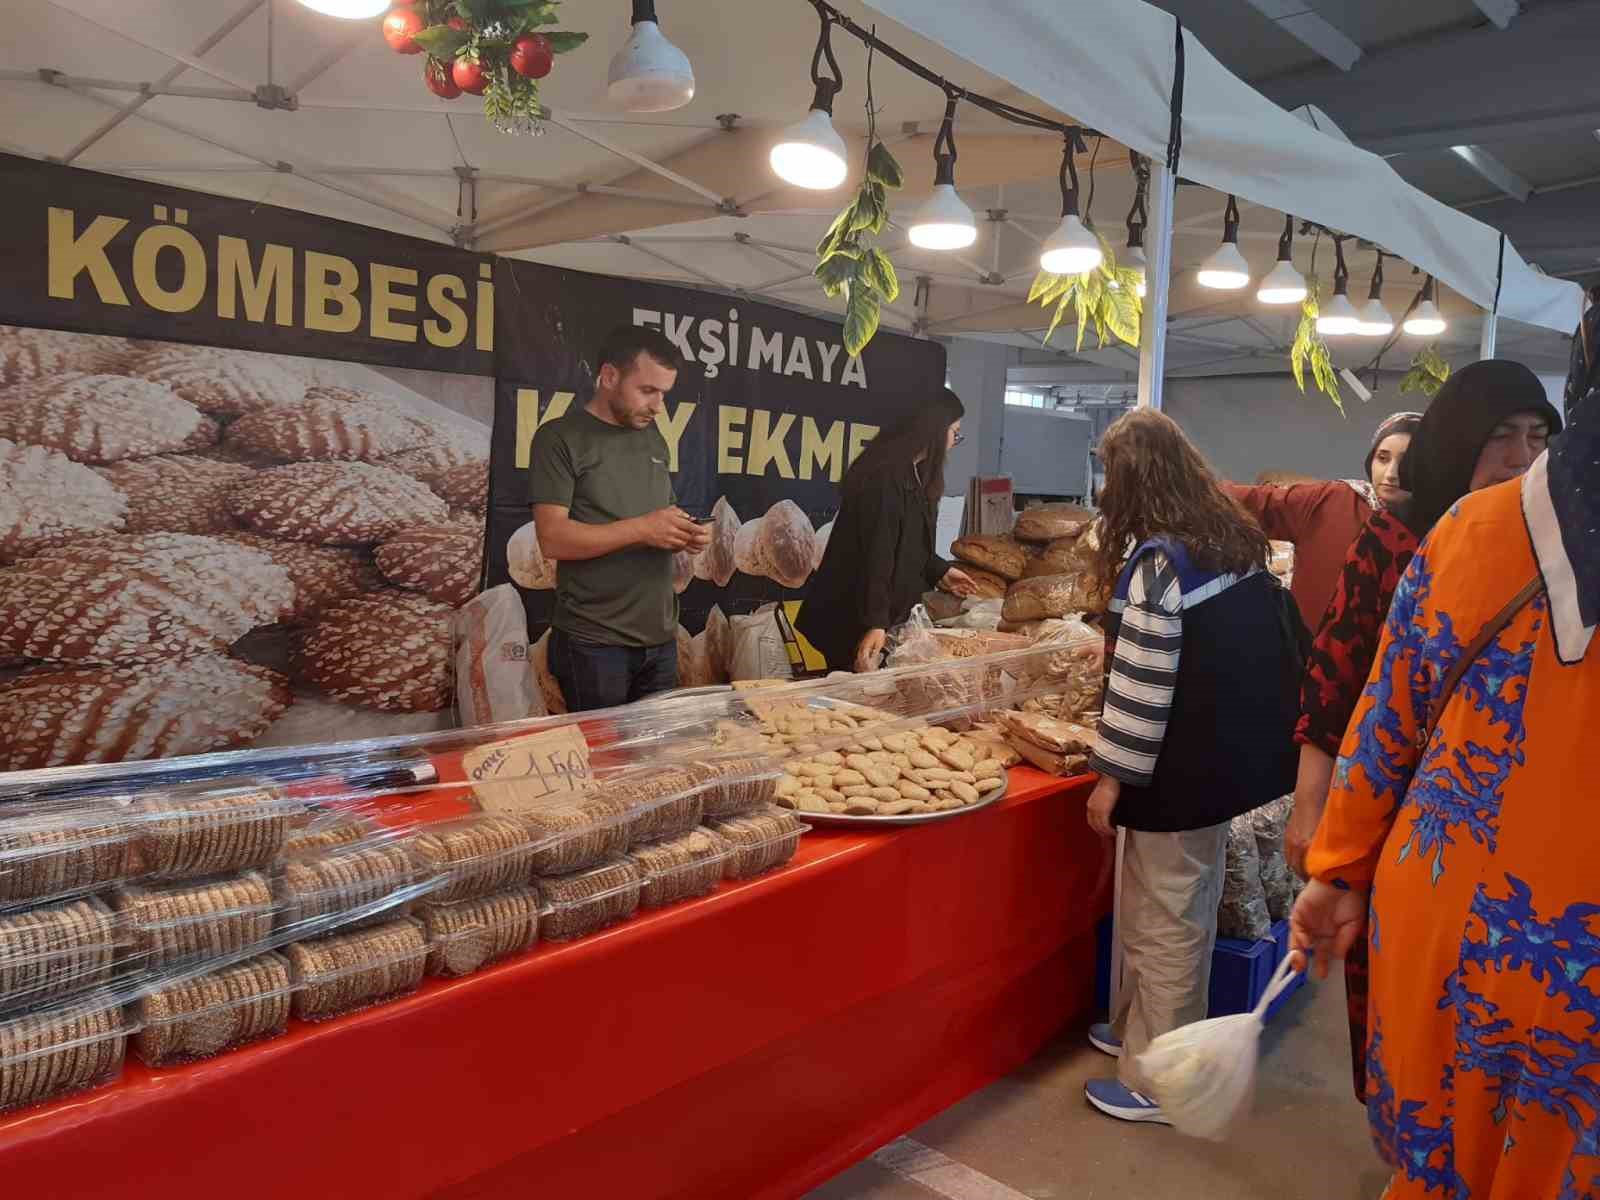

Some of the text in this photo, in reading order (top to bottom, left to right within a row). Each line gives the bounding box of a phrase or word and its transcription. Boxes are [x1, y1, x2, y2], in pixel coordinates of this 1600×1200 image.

[47, 204, 495, 352] KÖMBESİ
[747, 326, 868, 390] MAYA
[515, 388, 697, 473] KY
